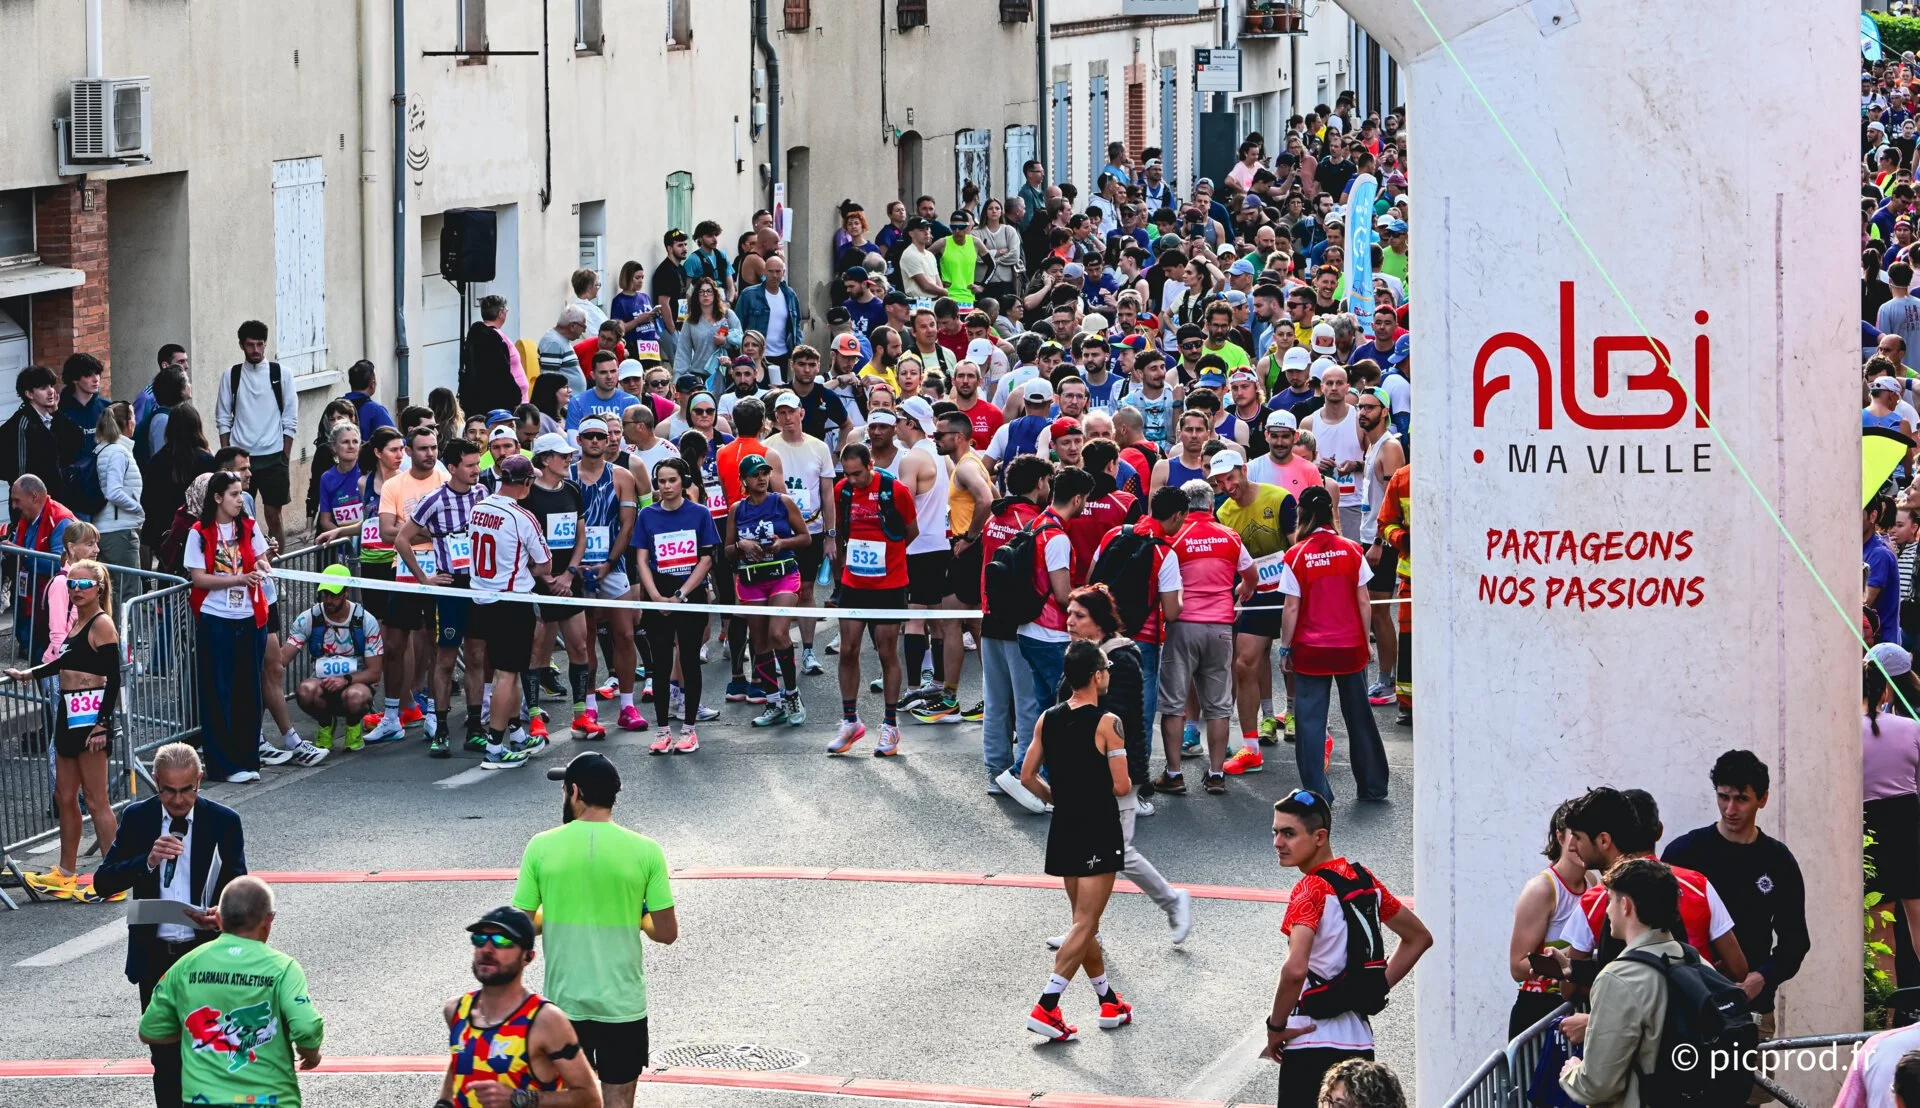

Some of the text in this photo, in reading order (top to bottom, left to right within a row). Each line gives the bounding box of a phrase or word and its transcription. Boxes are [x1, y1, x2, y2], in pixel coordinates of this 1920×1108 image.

[1508, 443, 1712, 473] MA VILLE
[658, 540, 695, 557] 3542
[1185, 536, 1229, 546] Marathon
[1186, 544, 1213, 553] d'albi
[1486, 528, 1694, 565] PARTAGEONS
[471, 531, 497, 579] 10
[852, 549, 878, 565] 532
[1304, 549, 1348, 561] Marathon
[399, 560, 435, 574] 175
[1305, 559, 1331, 568] d'albi
[1478, 574, 1705, 612] NOS PASSIONS
[323, 661, 350, 676] 308
[70, 695, 102, 713] 836
[188, 972, 275, 987] US CARMAUX ATHLETISME
